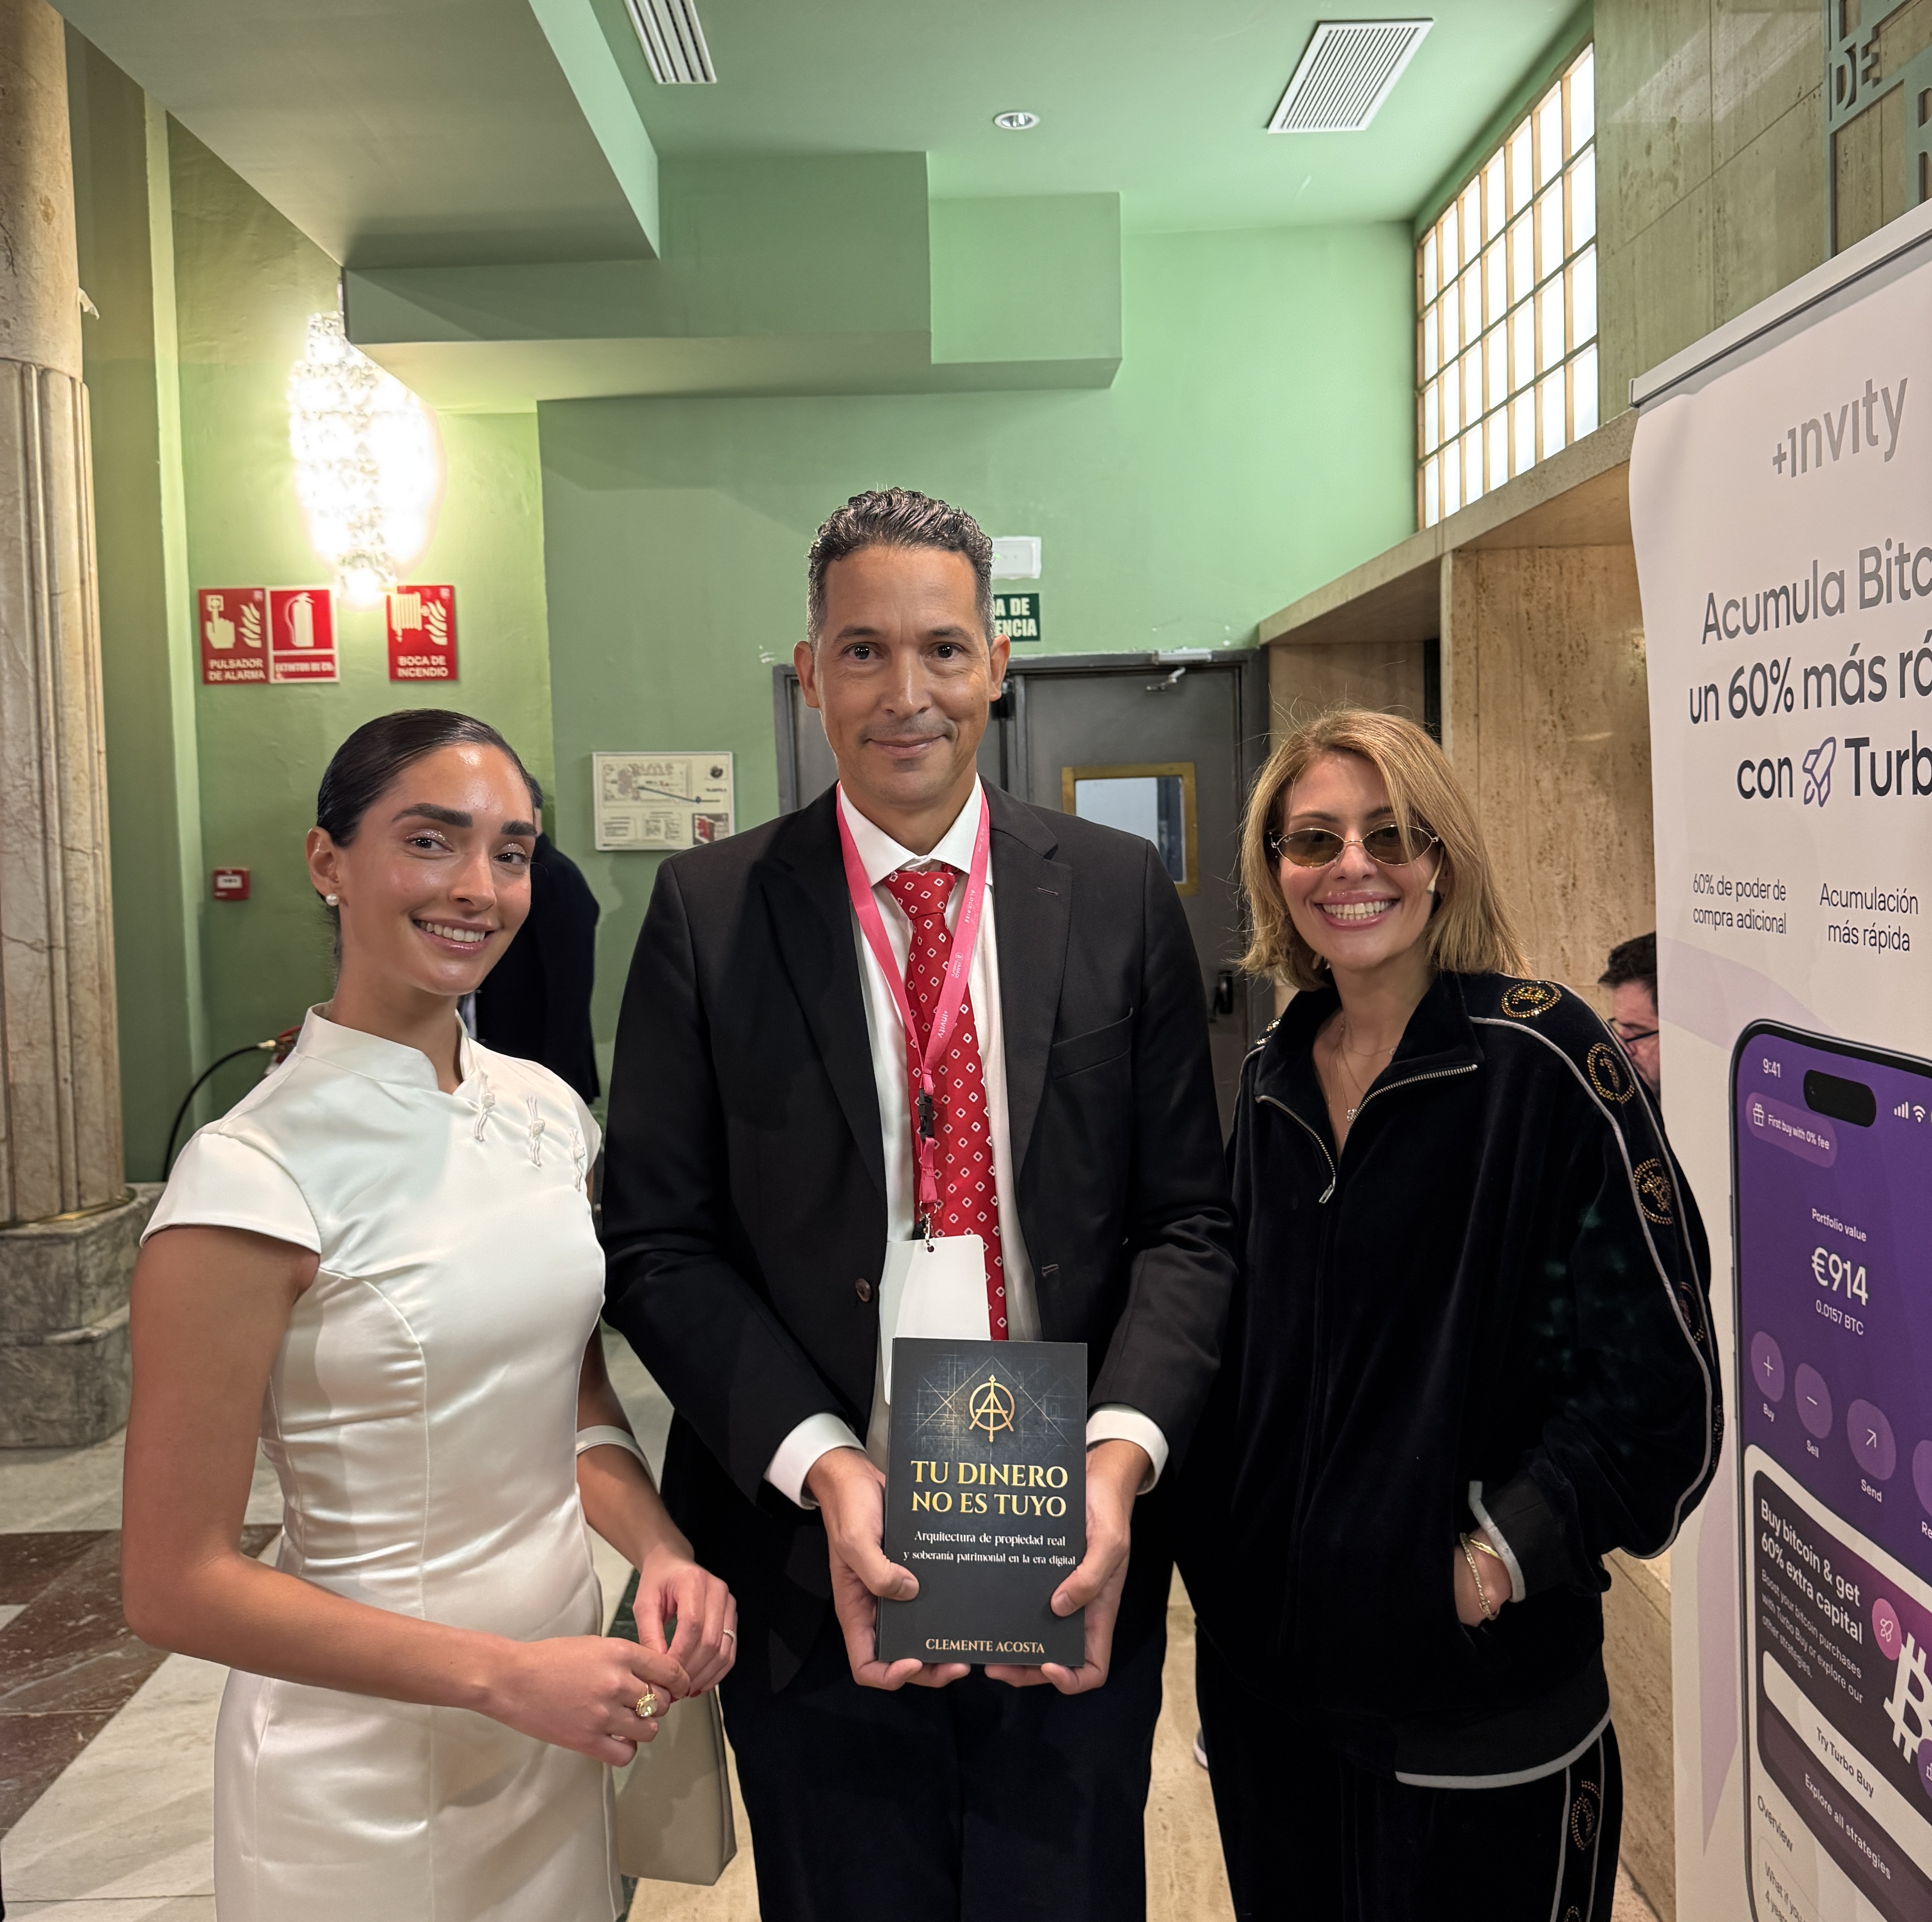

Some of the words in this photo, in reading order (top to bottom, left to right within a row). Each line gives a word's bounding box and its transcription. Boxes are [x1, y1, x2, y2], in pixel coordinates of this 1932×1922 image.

[1830, 34, 1881, 118] DE
[1009, 597, 1030, 616] DE
[1702, 559, 1844, 645] Acumula
[209, 657, 264, 669] PULSADOR
[209, 670, 223, 681] DE
[224, 669, 265, 680] ALARMA
[397, 666, 449, 677] INCENDIO
[398, 655, 430, 666] BOCA
[431, 655, 446, 665] DE
[1690, 684, 1719, 724] un
[1728, 657, 1794, 719] 60%
[1803, 642, 1887, 709] más
[1737, 757, 1793, 800] con
[1693, 873, 1714, 895] 60%
[1717, 875, 1732, 896] de
[1736, 877, 1771, 902] poder
[1773, 879, 1786, 901] de
[1820, 883, 1918, 915] Acumulación
[1693, 908, 1733, 931] compra
[1737, 908, 1786, 934] adicional
[1828, 920, 1859, 945] más
[1863, 922, 1910, 954] rápida
[1763, 1058, 1781, 1078] 9:41
[1768, 1114, 1781, 1130] First
[1782, 1121, 1792, 1137] buy
[1793, 1126, 1805, 1140] with
[1806, 1131, 1816, 1145] 0%
[1817, 1135, 1830, 1149] fee
[1812, 1208, 1843, 1232] Portfolio
[1845, 1226, 1867, 1242] value
[1811, 1247, 1868, 1306] €914
[1816, 1299, 1843, 1324] 0.0157
[1844, 1314, 1864, 1336] BTC
[910, 1460, 949, 1484] TU
[957, 1462, 1068, 1489] DINERO
[1861, 1479, 1882, 1503] Send
[911, 1491, 952, 1512] NO
[960, 1493, 988, 1514] ES
[994, 1494, 1067, 1517] TUYO
[914, 1531, 975, 1544] Arquitectura
[979, 1533, 992, 1543] de
[994, 1534, 1043, 1547] propiedad
[1046, 1536, 1066, 1546] real
[1761, 1498, 1781, 1537] Buy
[1783, 1519, 1820, 1573] bitcoin
[1823, 1559, 1833, 1585] &
[1836, 1575, 1860, 1607] get
[903, 1551, 910, 1561] y
[957, 1553, 1006, 1564] patrimonial
[1008, 1555, 1019, 1564] en
[1022, 1554, 1030, 1564] la
[1032, 1556, 1046, 1564] era
[1049, 1555, 1076, 1567] digital
[1761, 1532, 1784, 1569] 60%
[1786, 1561, 1814, 1600] extra
[1816, 1592, 1862, 1645] capital
[925, 1638, 993, 1652] CLEMENTE
[995, 1641, 1045, 1653] ACOSTA
[1776, 1605, 1794, 1634] Turbo
[1795, 1627, 1808, 1652] Buy
[1808, 1645, 1816, 1658] or
[1817, 1655, 1846, 1689] explore
[1848, 1685, 1863, 1703] our
[1795, 1604, 1818, 1639] bitcoin
[1819, 1633, 1862, 1679] purchases
[1816, 1727, 1829, 1752] Try
[1830, 1741, 1854, 1777] Turbo
[1857, 1768, 1874, 1798] Buy
[1758, 1795, 1793, 1852] Overview
[1805, 1773, 1832, 1815] Explore
[1834, 1811, 1844, 1829] all
[1846, 1824, 1891, 1880] strategies
